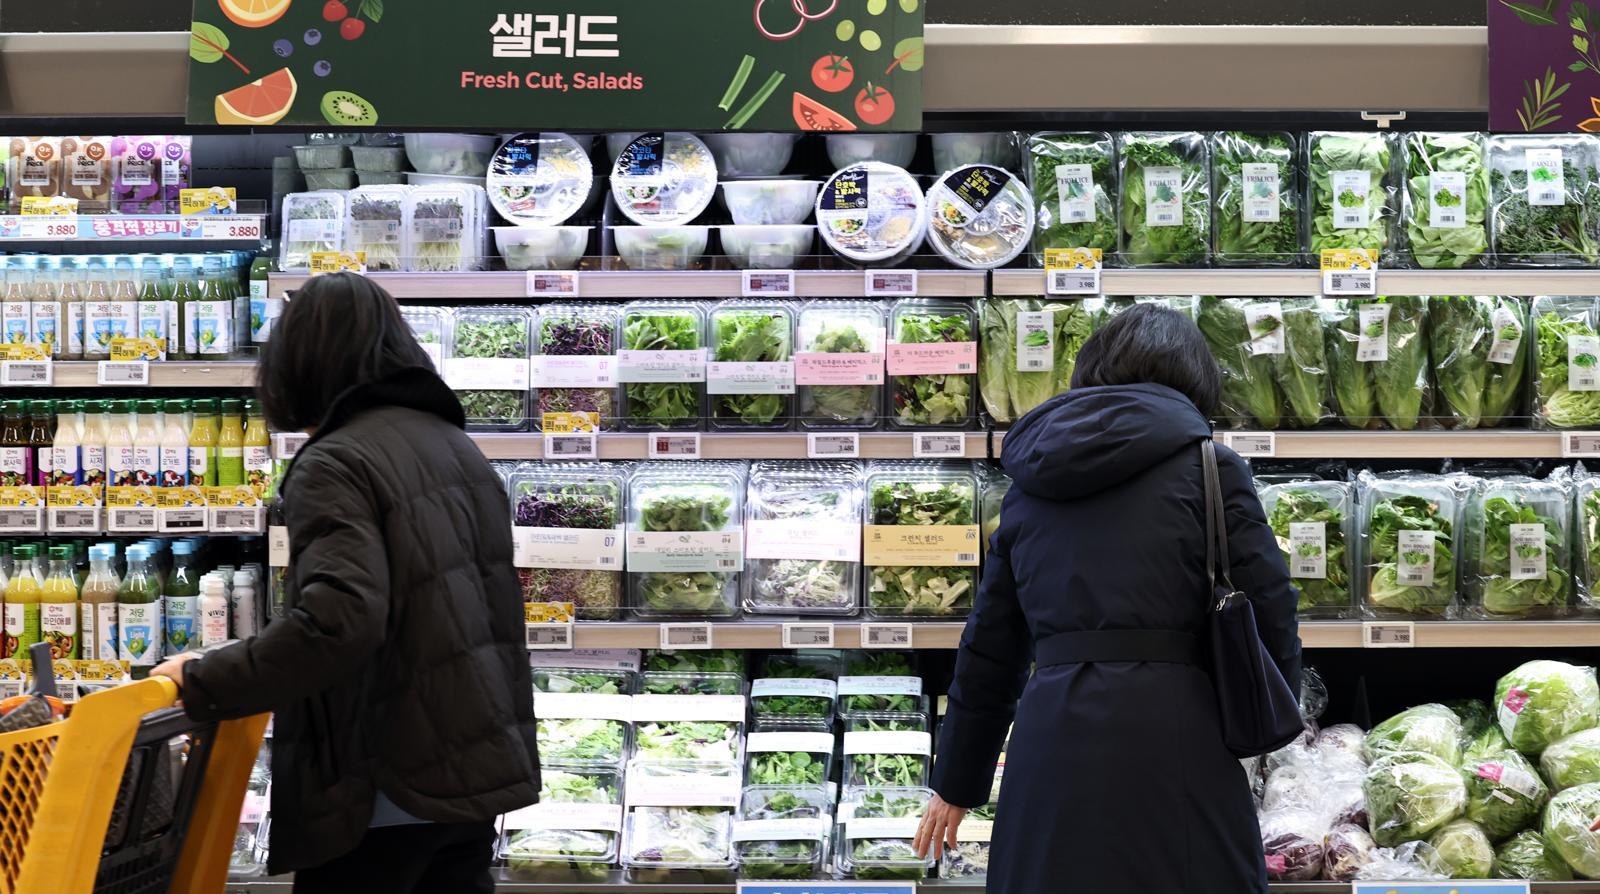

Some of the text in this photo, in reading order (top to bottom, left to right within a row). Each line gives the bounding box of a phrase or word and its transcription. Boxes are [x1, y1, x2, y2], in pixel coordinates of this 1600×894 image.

[489, 13, 620, 57] 샐러드
[461, 71, 644, 93] Fresh Cut, Salads
